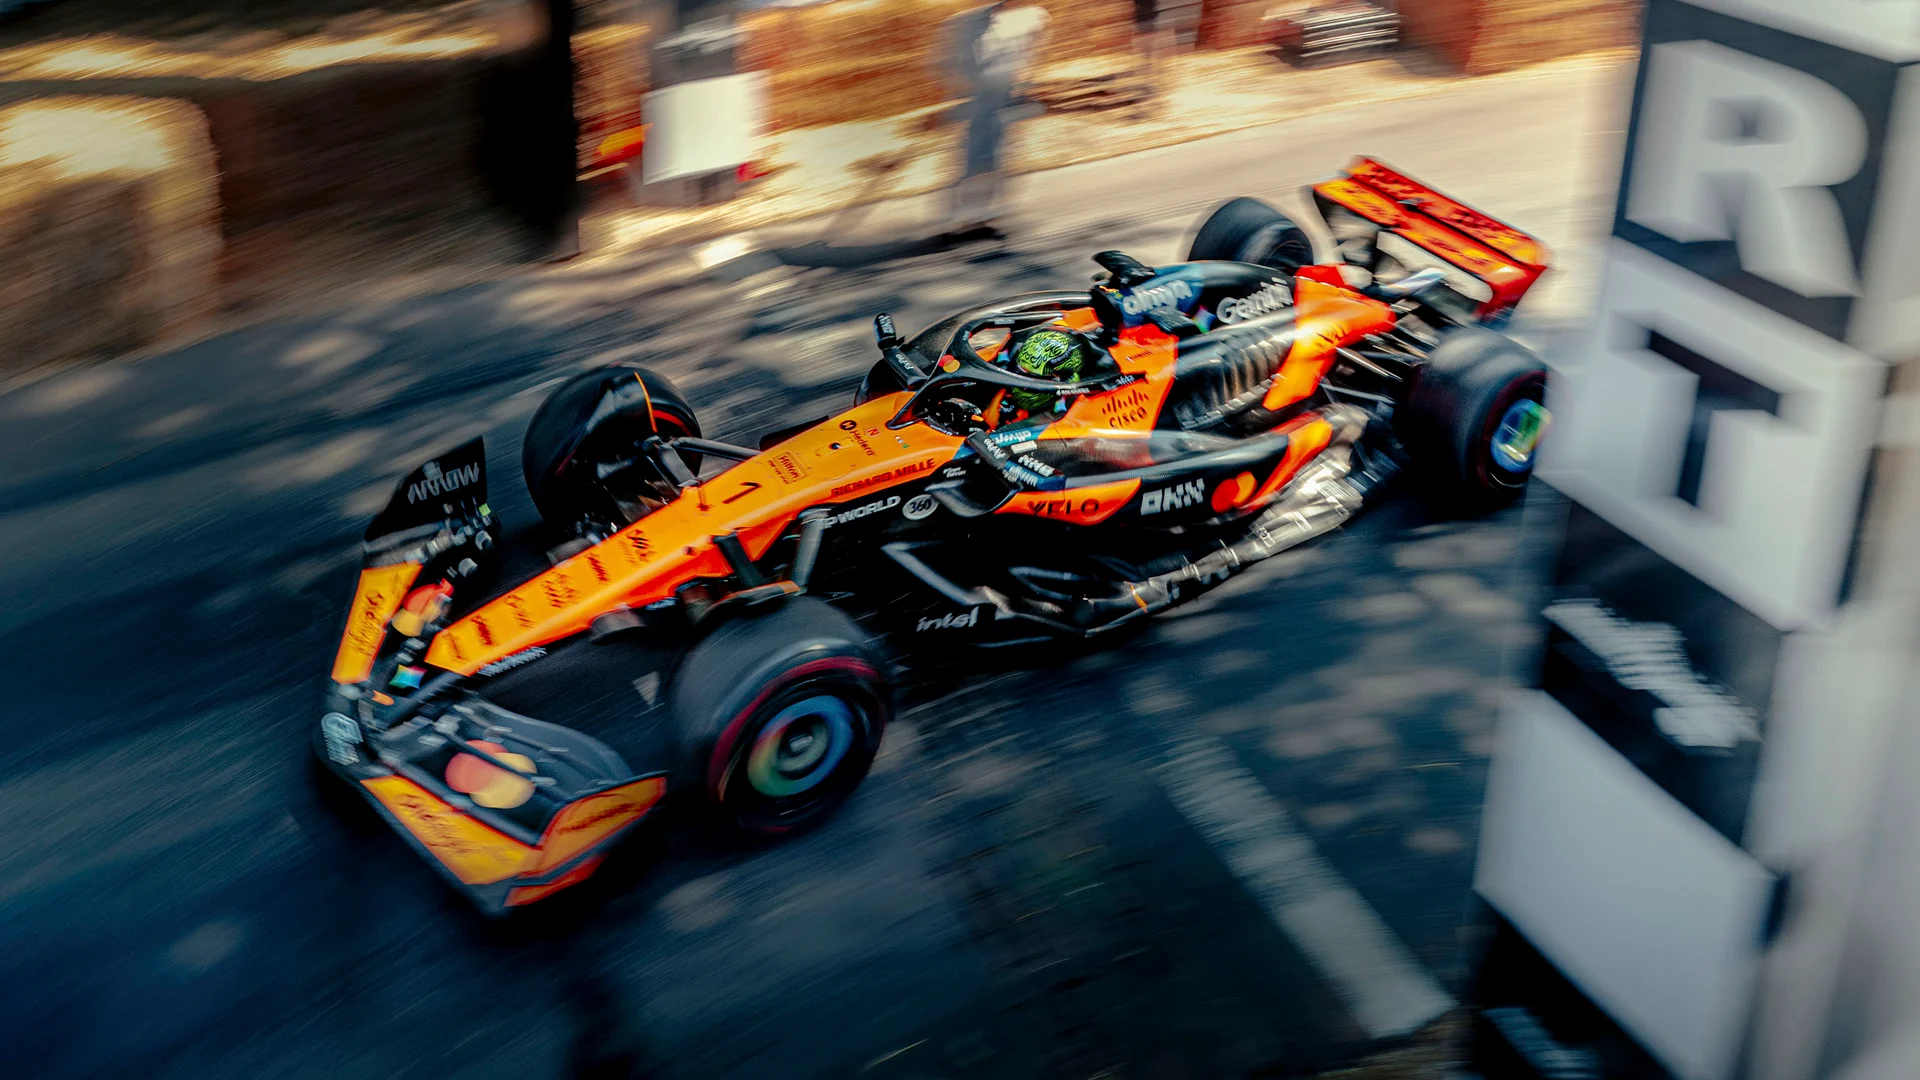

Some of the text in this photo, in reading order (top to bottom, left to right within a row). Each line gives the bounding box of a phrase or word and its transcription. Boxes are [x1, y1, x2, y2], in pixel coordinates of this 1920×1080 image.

[1216, 276, 1294, 324] Gemini
[778, 455, 799, 479] Hilton
[892, 457, 937, 479] MILLE
[909, 497, 933, 516] 360
[915, 605, 979, 632] intel
